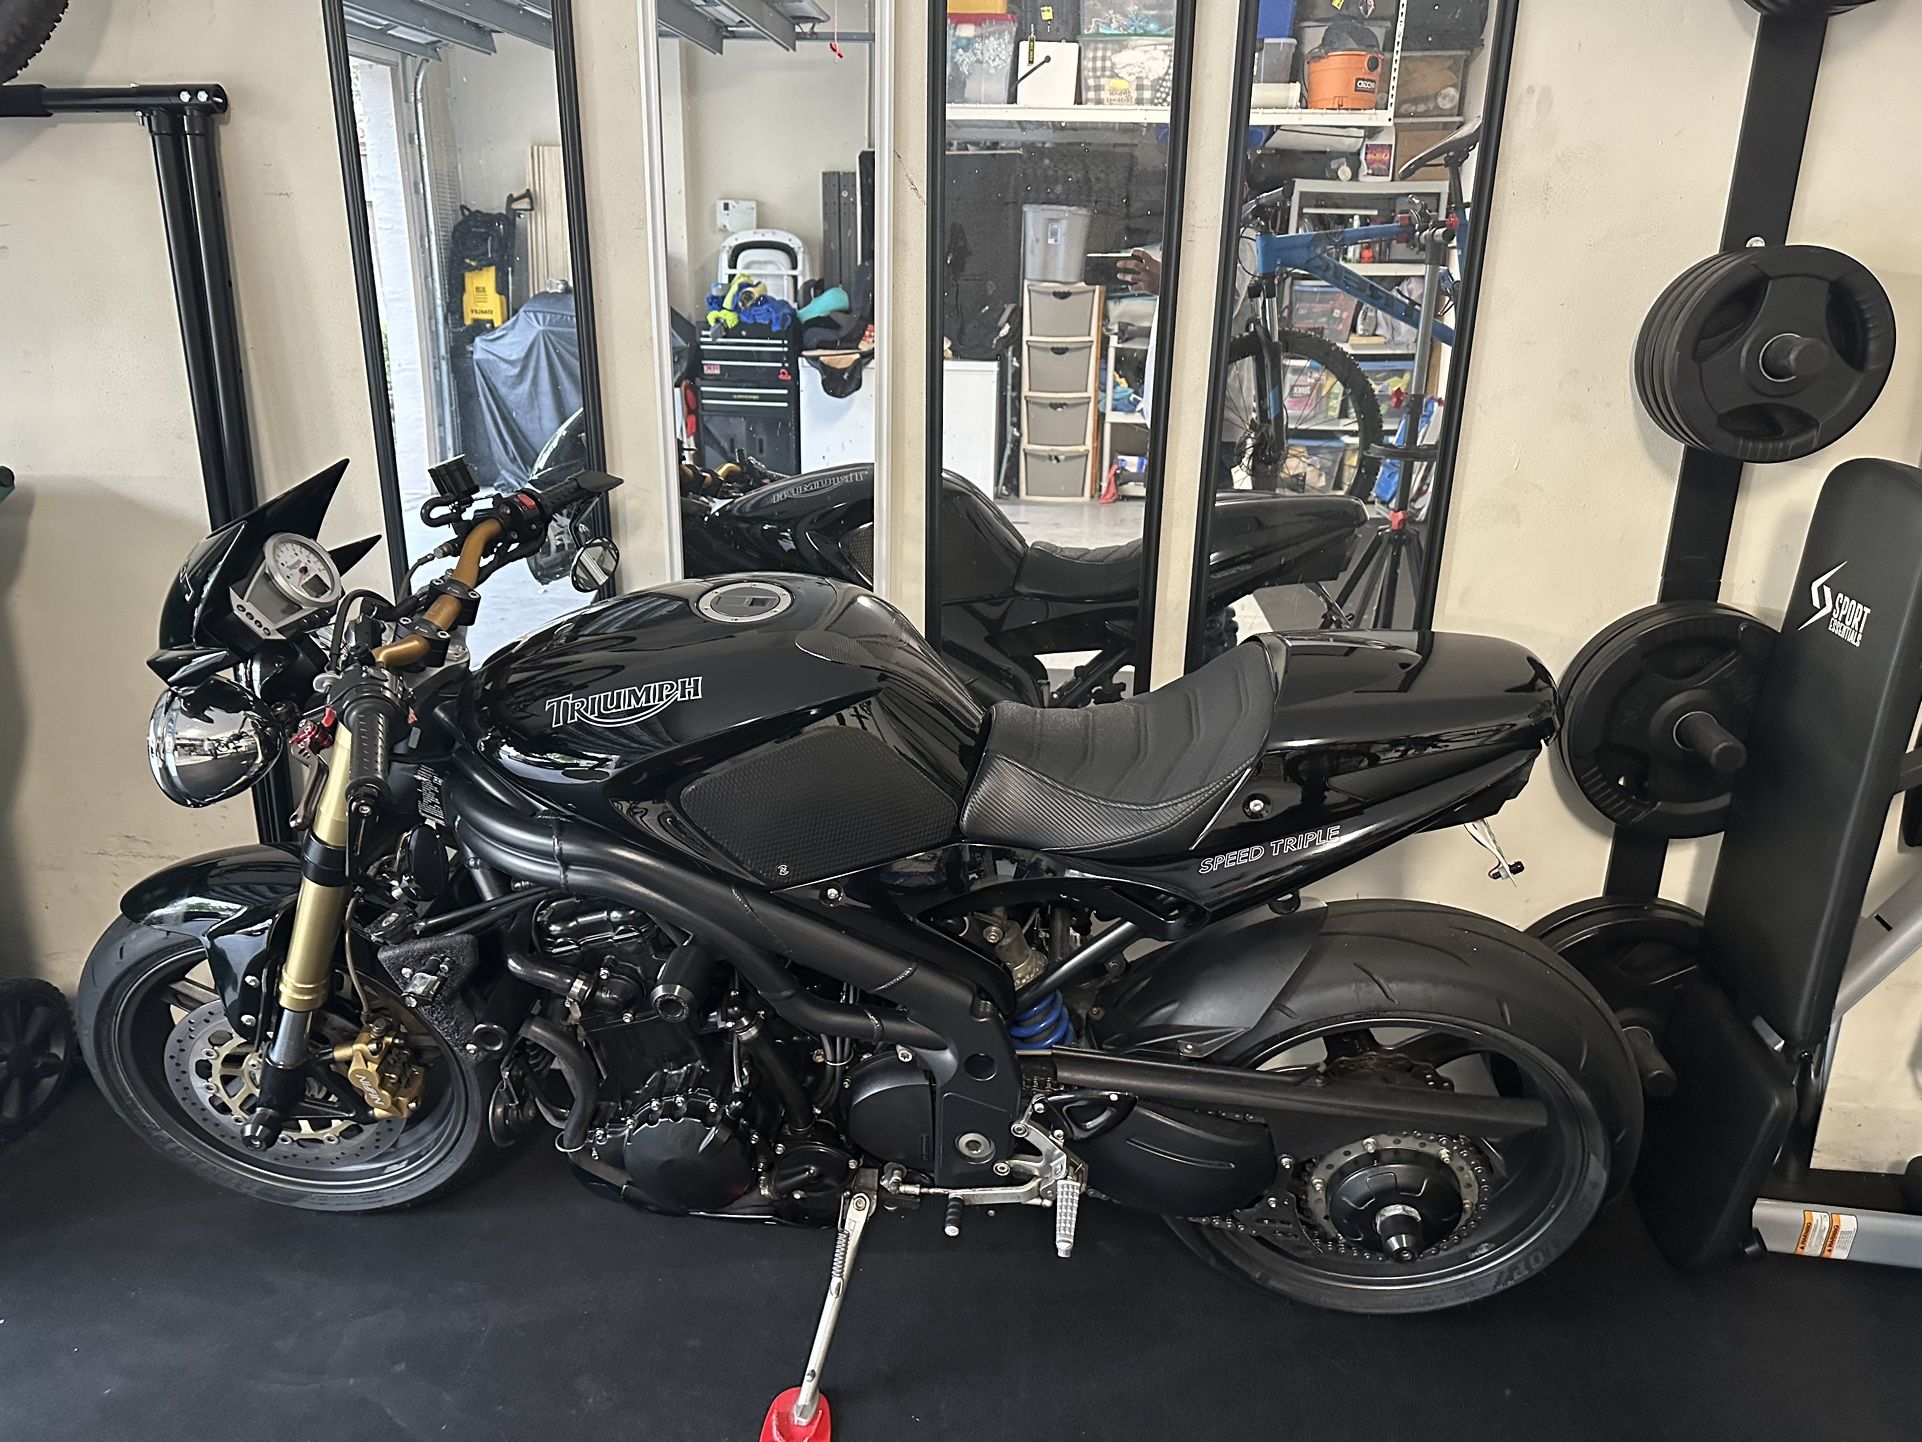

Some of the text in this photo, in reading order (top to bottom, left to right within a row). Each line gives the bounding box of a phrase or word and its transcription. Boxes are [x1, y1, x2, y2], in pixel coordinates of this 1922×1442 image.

[1832, 592, 1871, 632] SPORT
[1828, 616, 1863, 648] ESSENTIALS
[545, 676, 703, 728] TRIUMPH
[1199, 825, 1340, 873] SPEED TRIPLE
[1801, 1222, 1812, 1245] WARNING
[1827, 1225, 1840, 1248] WARNING
